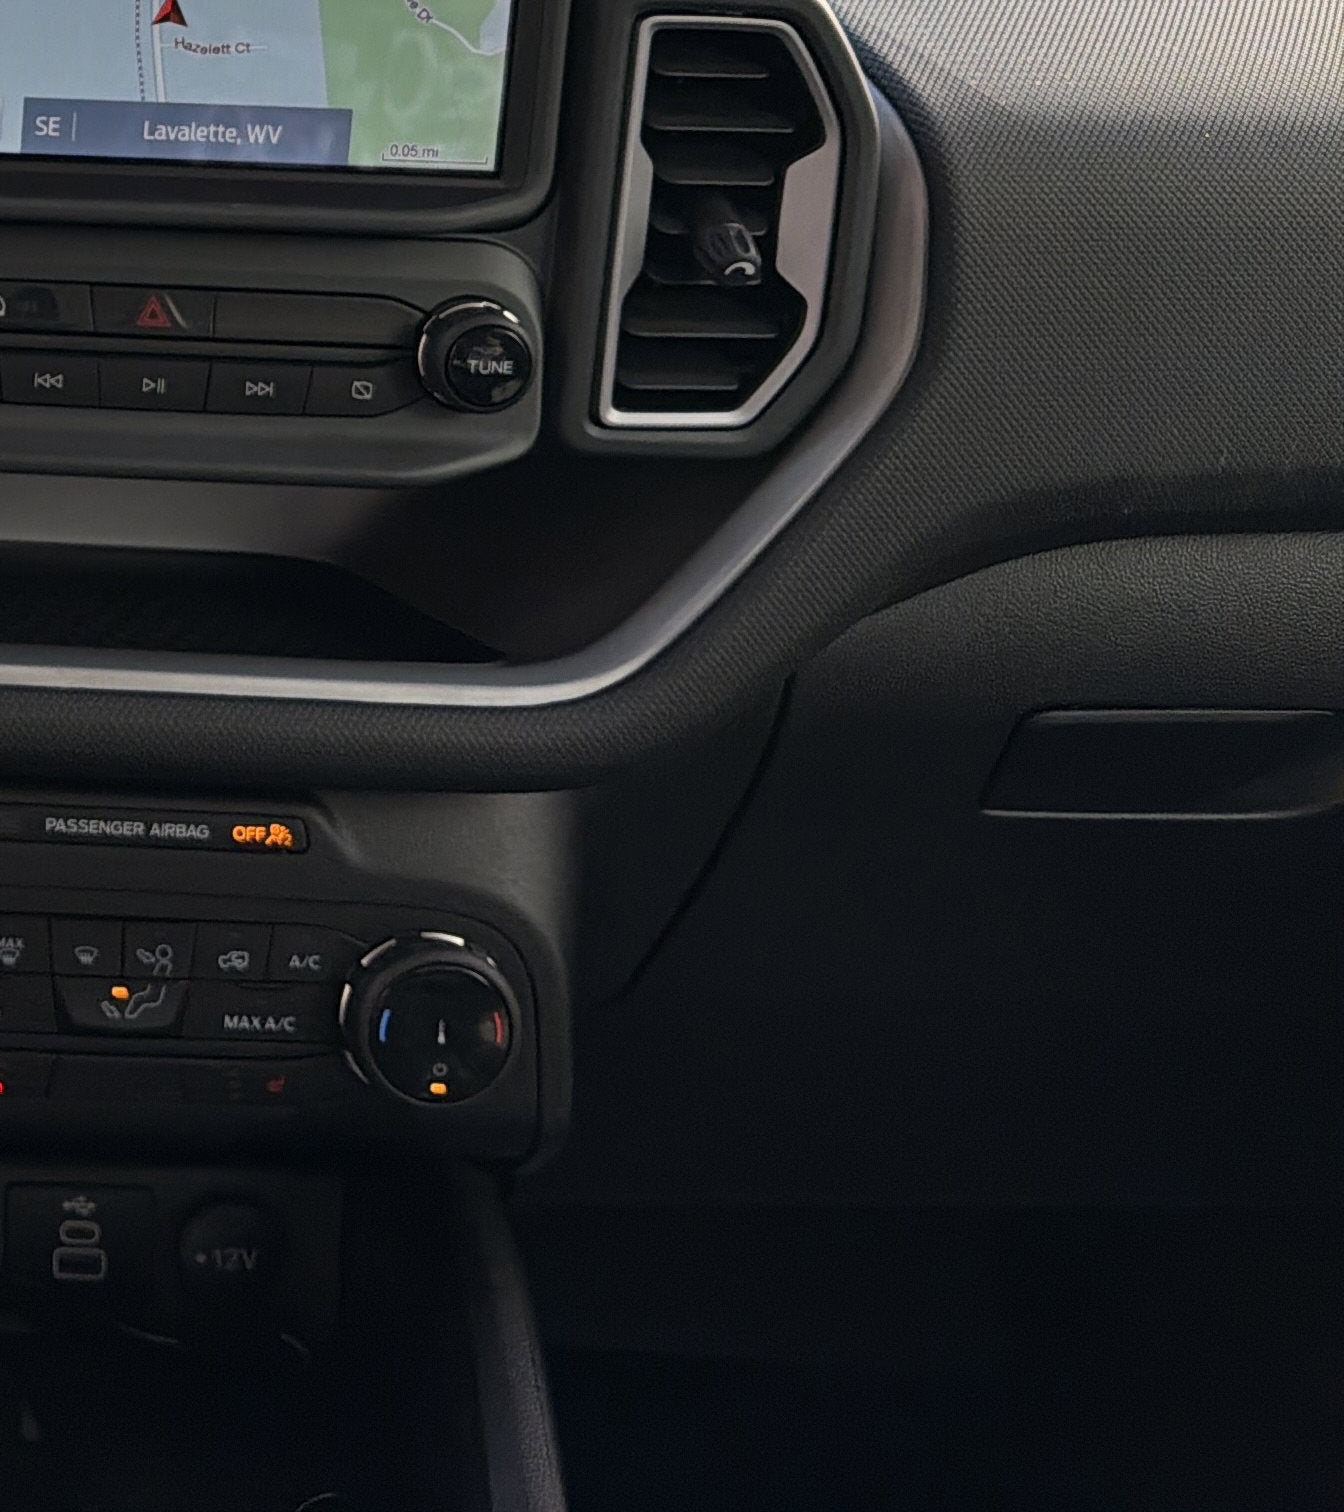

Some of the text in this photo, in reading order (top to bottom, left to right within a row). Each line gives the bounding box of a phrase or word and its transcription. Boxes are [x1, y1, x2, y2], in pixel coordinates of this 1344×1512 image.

[416, 7, 433, 24] Dr
[174, 36, 251, 55] Hazelett Ct
[34, 115, 61, 137] SE
[143, 119, 283, 146] Lavalette, WV
[389, 143, 439, 158] 0.05 mi
[466, 359, 514, 375] TUNE
[44, 817, 267, 843] PASSENGER AIRBAG OFF
[288, 954, 322, 970] A/C
[223, 1014, 297, 1033] MAX A/C
[214, 1248, 257, 1272] 12V
